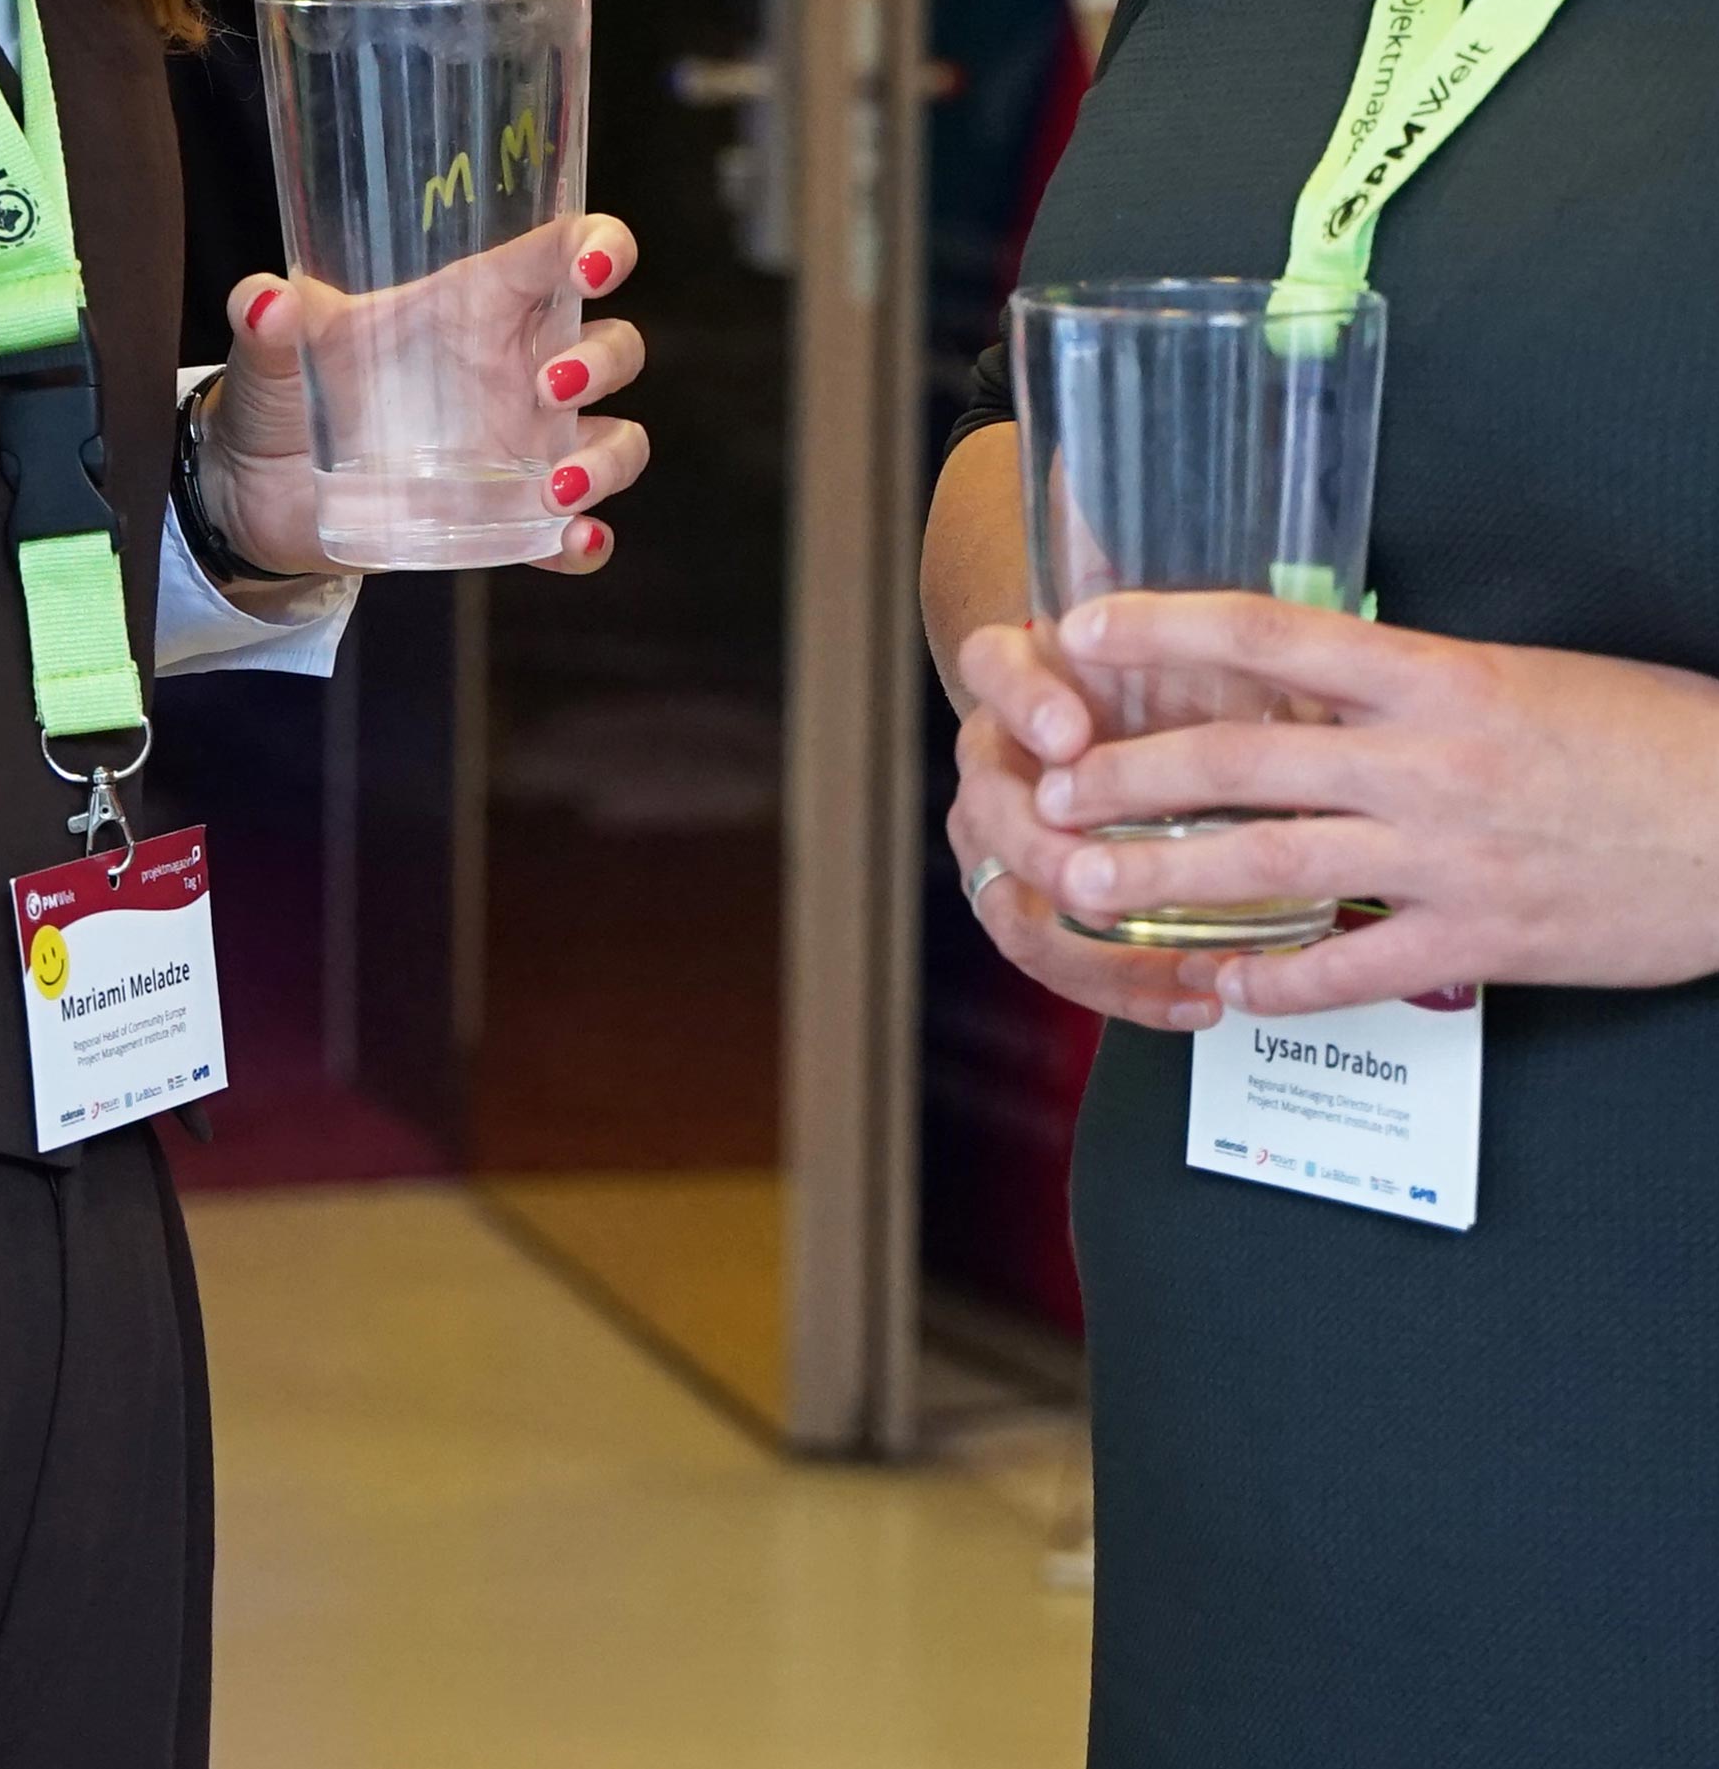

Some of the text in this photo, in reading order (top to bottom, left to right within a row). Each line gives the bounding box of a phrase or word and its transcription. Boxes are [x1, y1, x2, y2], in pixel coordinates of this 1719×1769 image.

[61, 961, 190, 1022] Mariami Meladze
[128, 1014, 164, 1034] Community
[101, 1037, 143, 1058] Management
[1254, 1028, 1407, 1084] Lysan Drabon
